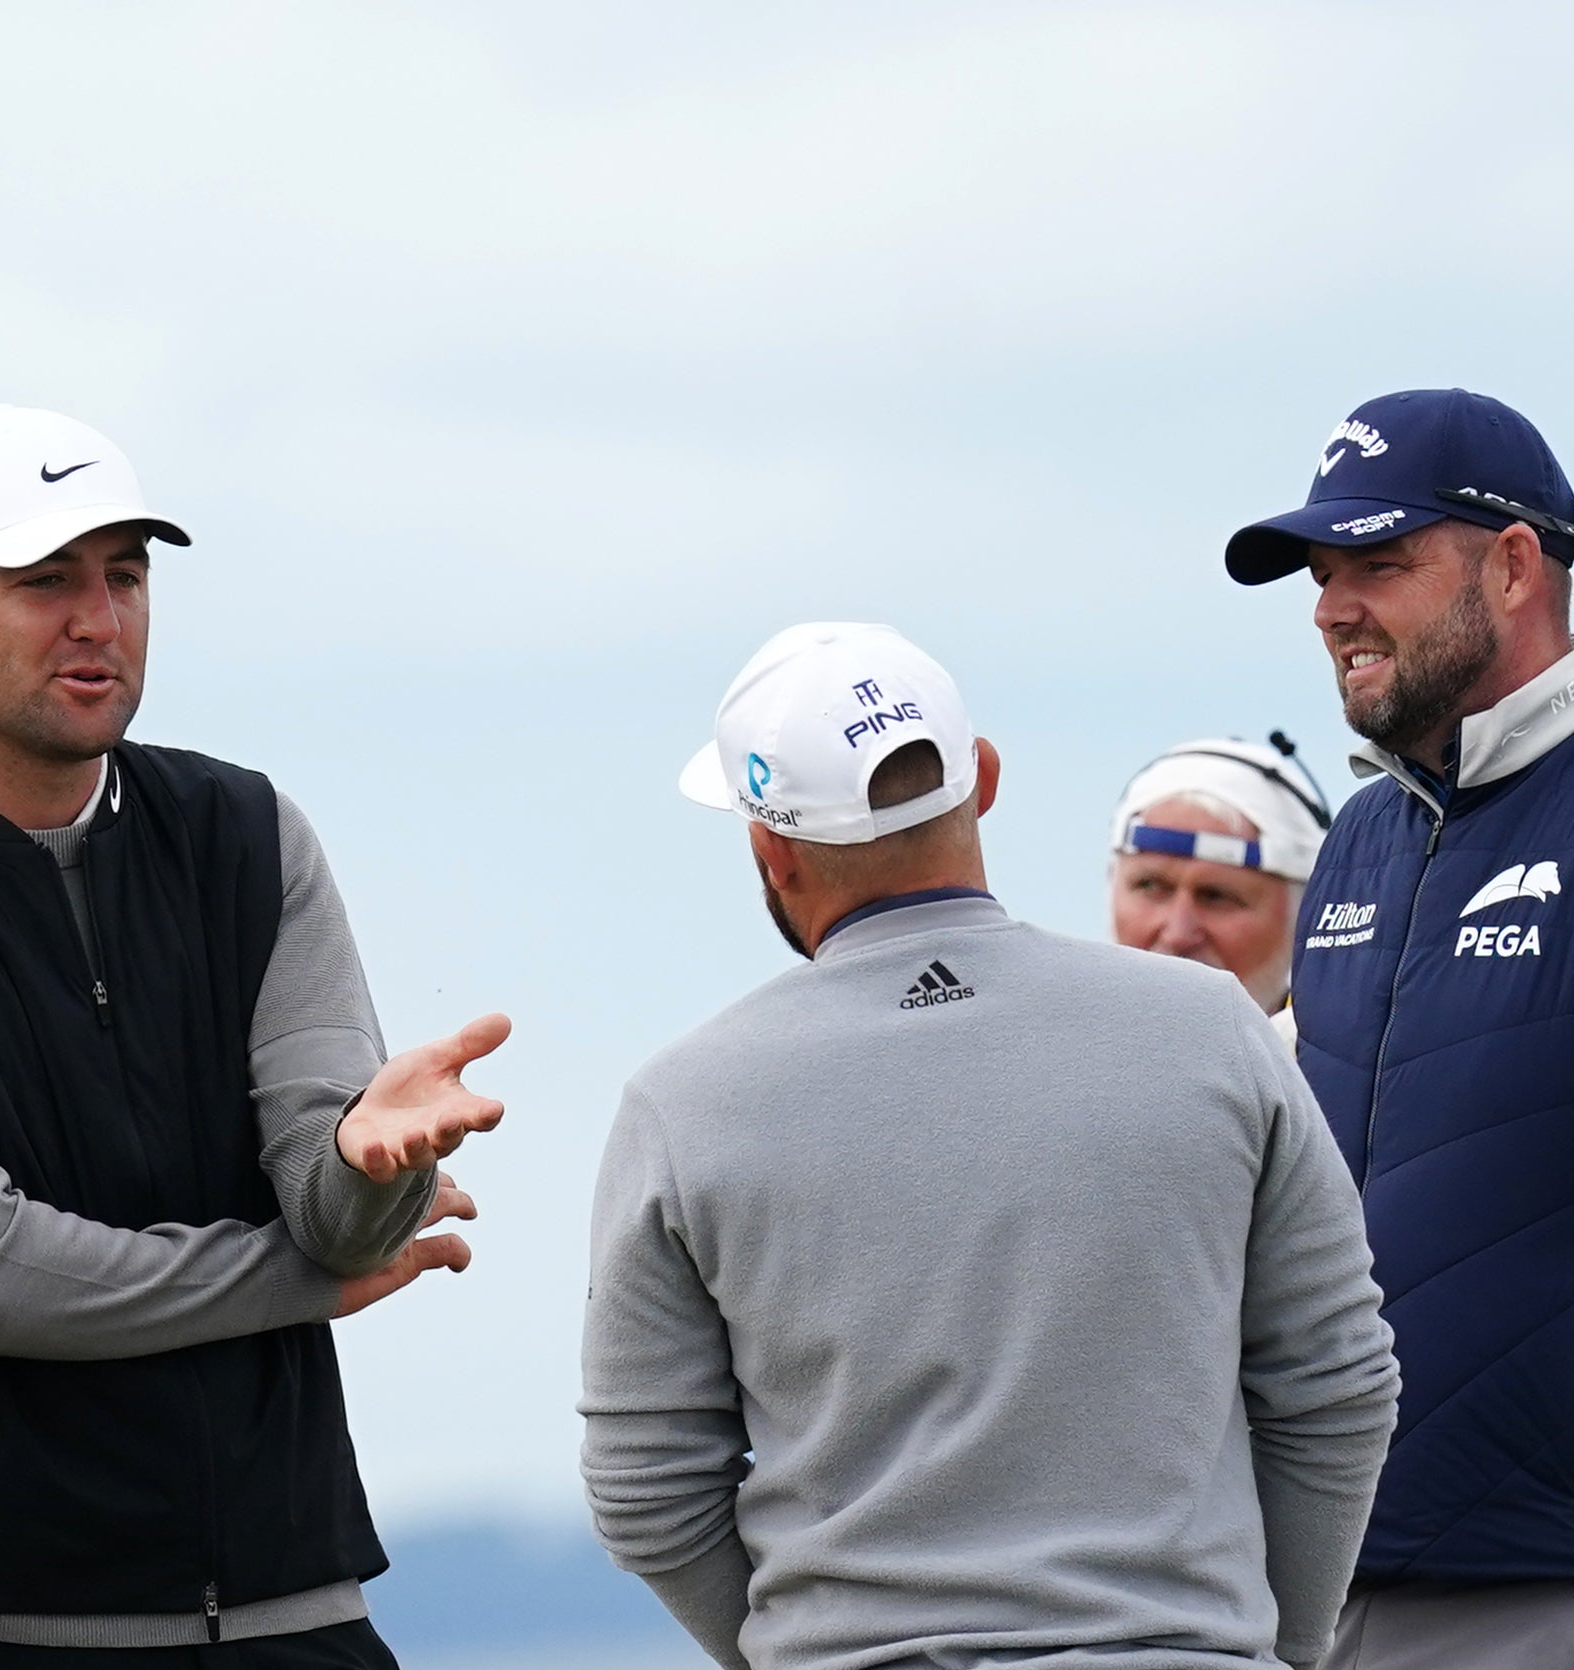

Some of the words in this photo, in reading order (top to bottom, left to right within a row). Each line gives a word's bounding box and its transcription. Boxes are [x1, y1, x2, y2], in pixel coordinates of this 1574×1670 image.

[1331, 509, 1406, 532] CHROME
[1350, 520, 1394, 536] SOFT
[844, 702, 923, 749] PING
[1316, 901, 1377, 931] Hilton
[1454, 924, 1542, 958] PEGA
[900, 986, 976, 1010] adidas
